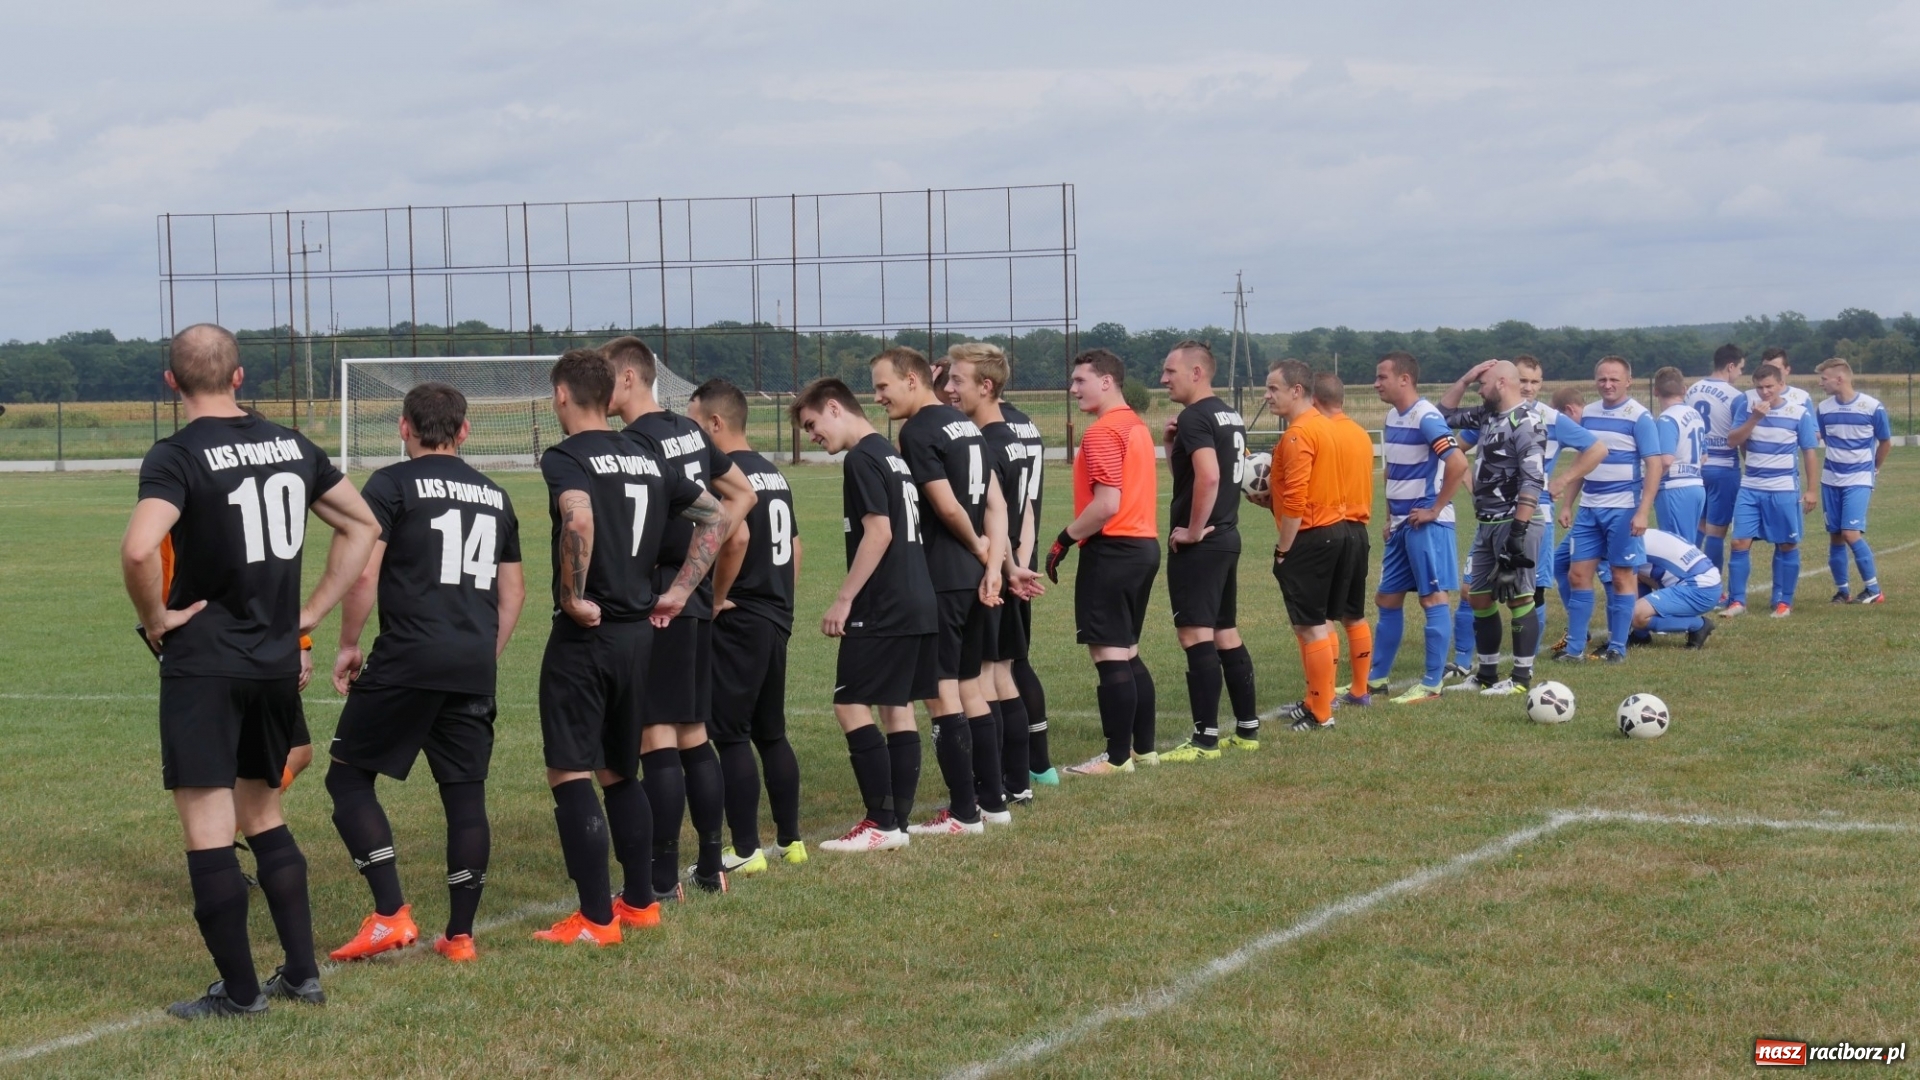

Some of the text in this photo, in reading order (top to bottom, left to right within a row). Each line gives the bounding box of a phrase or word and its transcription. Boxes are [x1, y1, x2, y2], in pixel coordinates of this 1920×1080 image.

[204, 437, 304, 471] LKS PAWŁÓW
[589, 455, 617, 474] LKS
[661, 436, 682, 459] LKS
[968, 444, 985, 505] 4
[1232, 431, 1245, 484] 3
[228, 471, 306, 564] 10
[415, 478, 504, 511] LKS PAWŁÓW
[624, 483, 649, 557] 7
[430, 508, 498, 590] 14
[768, 498, 792, 566] 9
